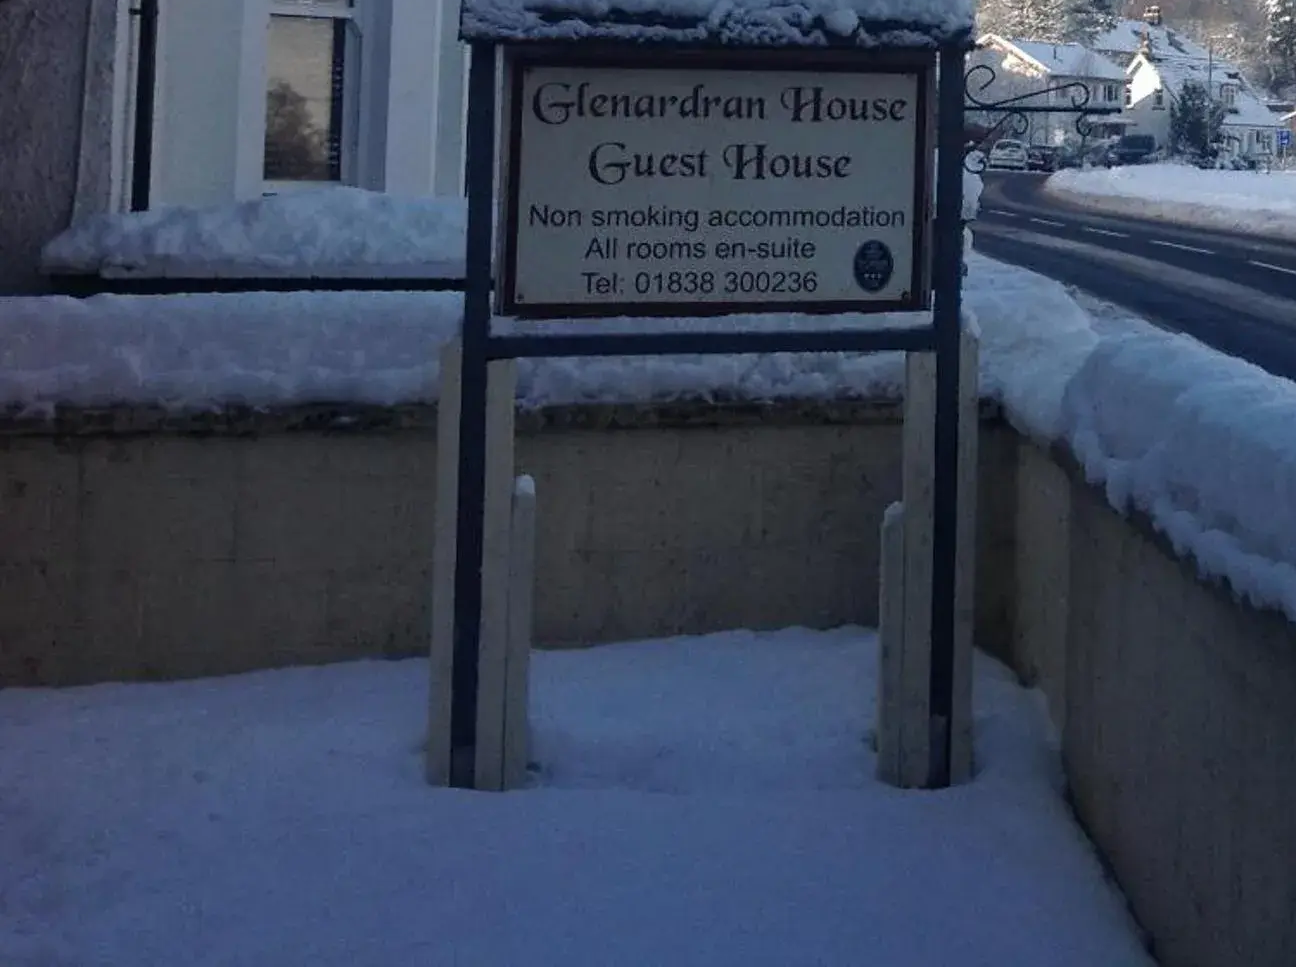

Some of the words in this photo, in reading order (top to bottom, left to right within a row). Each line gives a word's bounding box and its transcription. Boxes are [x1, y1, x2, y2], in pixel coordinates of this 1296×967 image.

[532, 81, 766, 125] Glenardran
[780, 86, 907, 123] House
[588, 142, 708, 185] Guest
[722, 143, 852, 180] House
[529, 204, 581, 227] Non
[591, 204, 698, 231] smoking
[708, 205, 905, 228] accommodation
[585, 237, 619, 260] All
[625, 240, 706, 260] rooms
[714, 237, 816, 260] en-suite
[582, 272, 625, 294] Tel:
[634, 271, 715, 294] 01838
[724, 271, 818, 293] 300236
